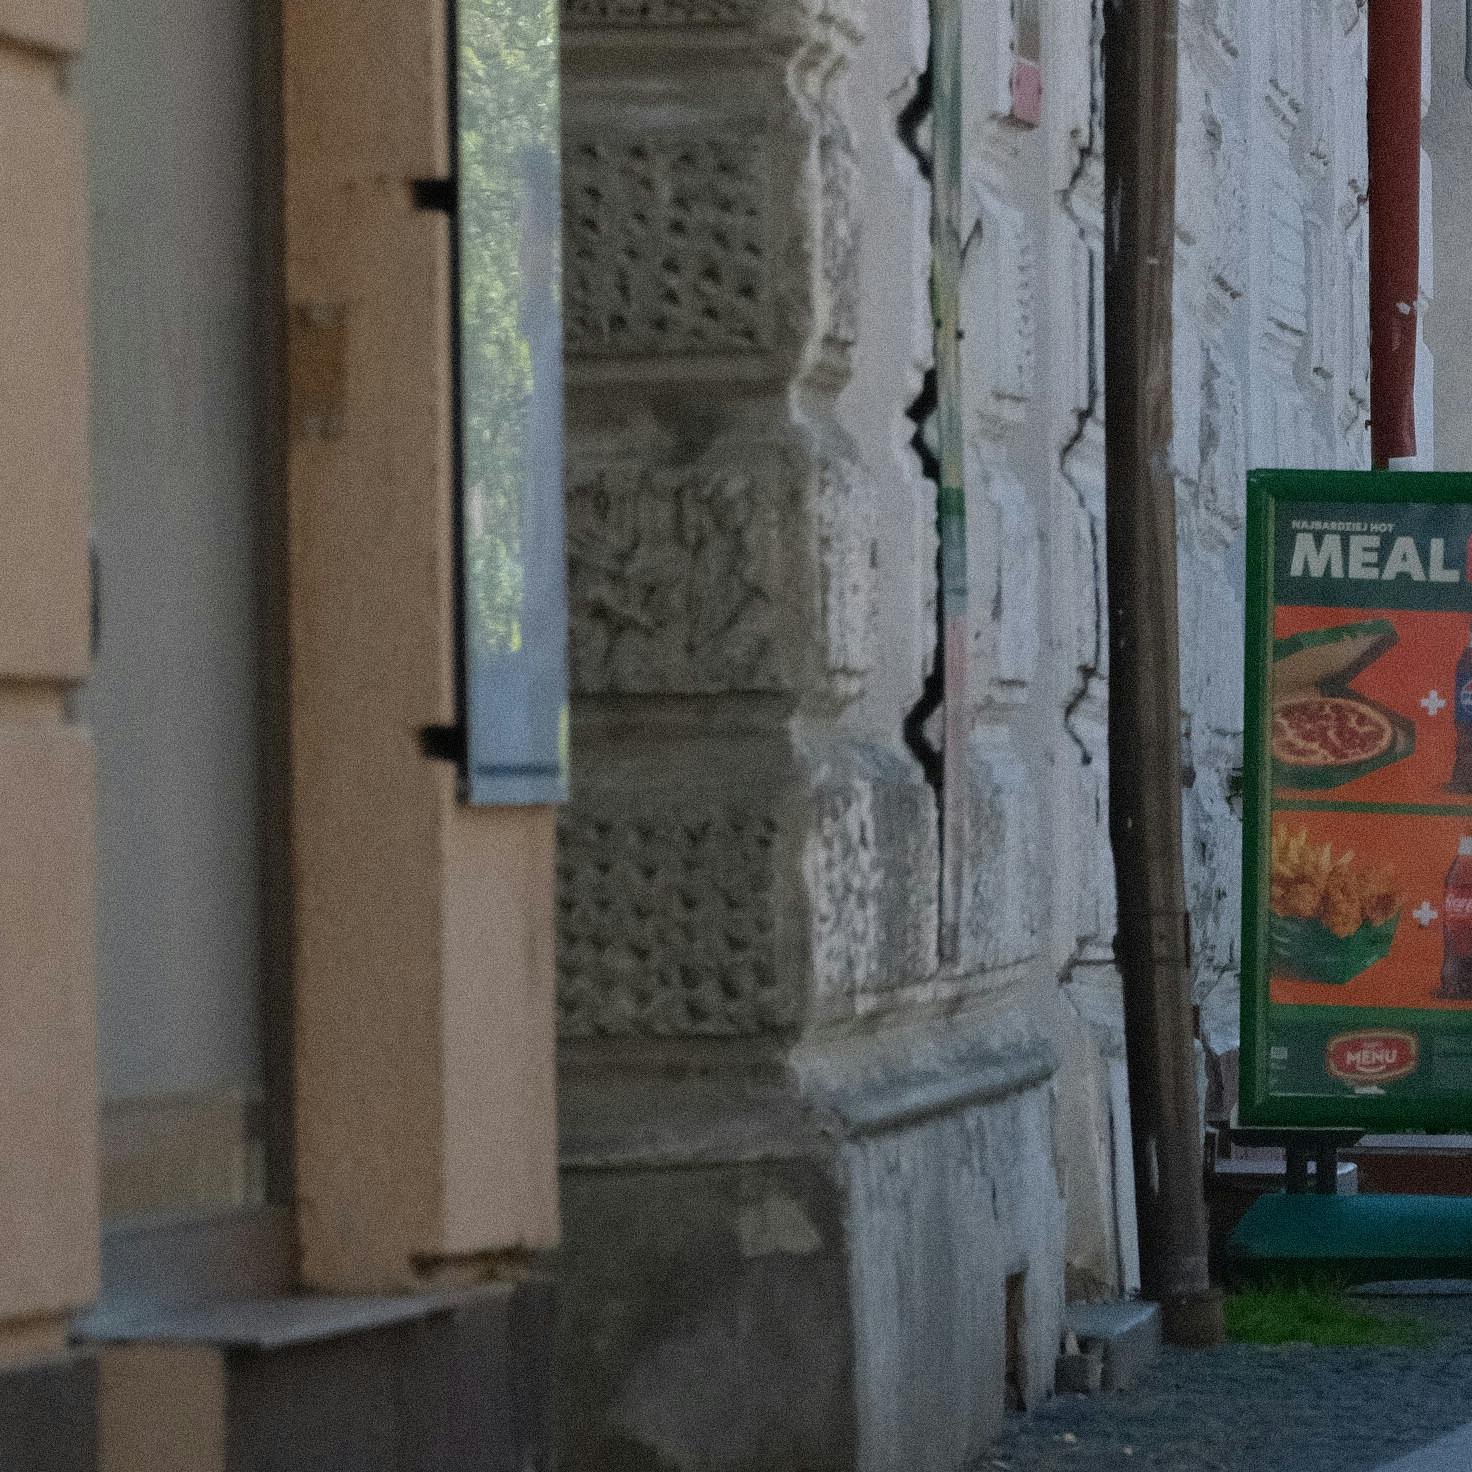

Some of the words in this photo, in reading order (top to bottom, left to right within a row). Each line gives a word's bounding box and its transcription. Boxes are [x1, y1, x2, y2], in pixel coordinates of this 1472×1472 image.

[1370, 522, 1395, 533] HOT
[1289, 532, 1460, 582] MEAL
[1345, 1049, 1398, 1066] MENU
